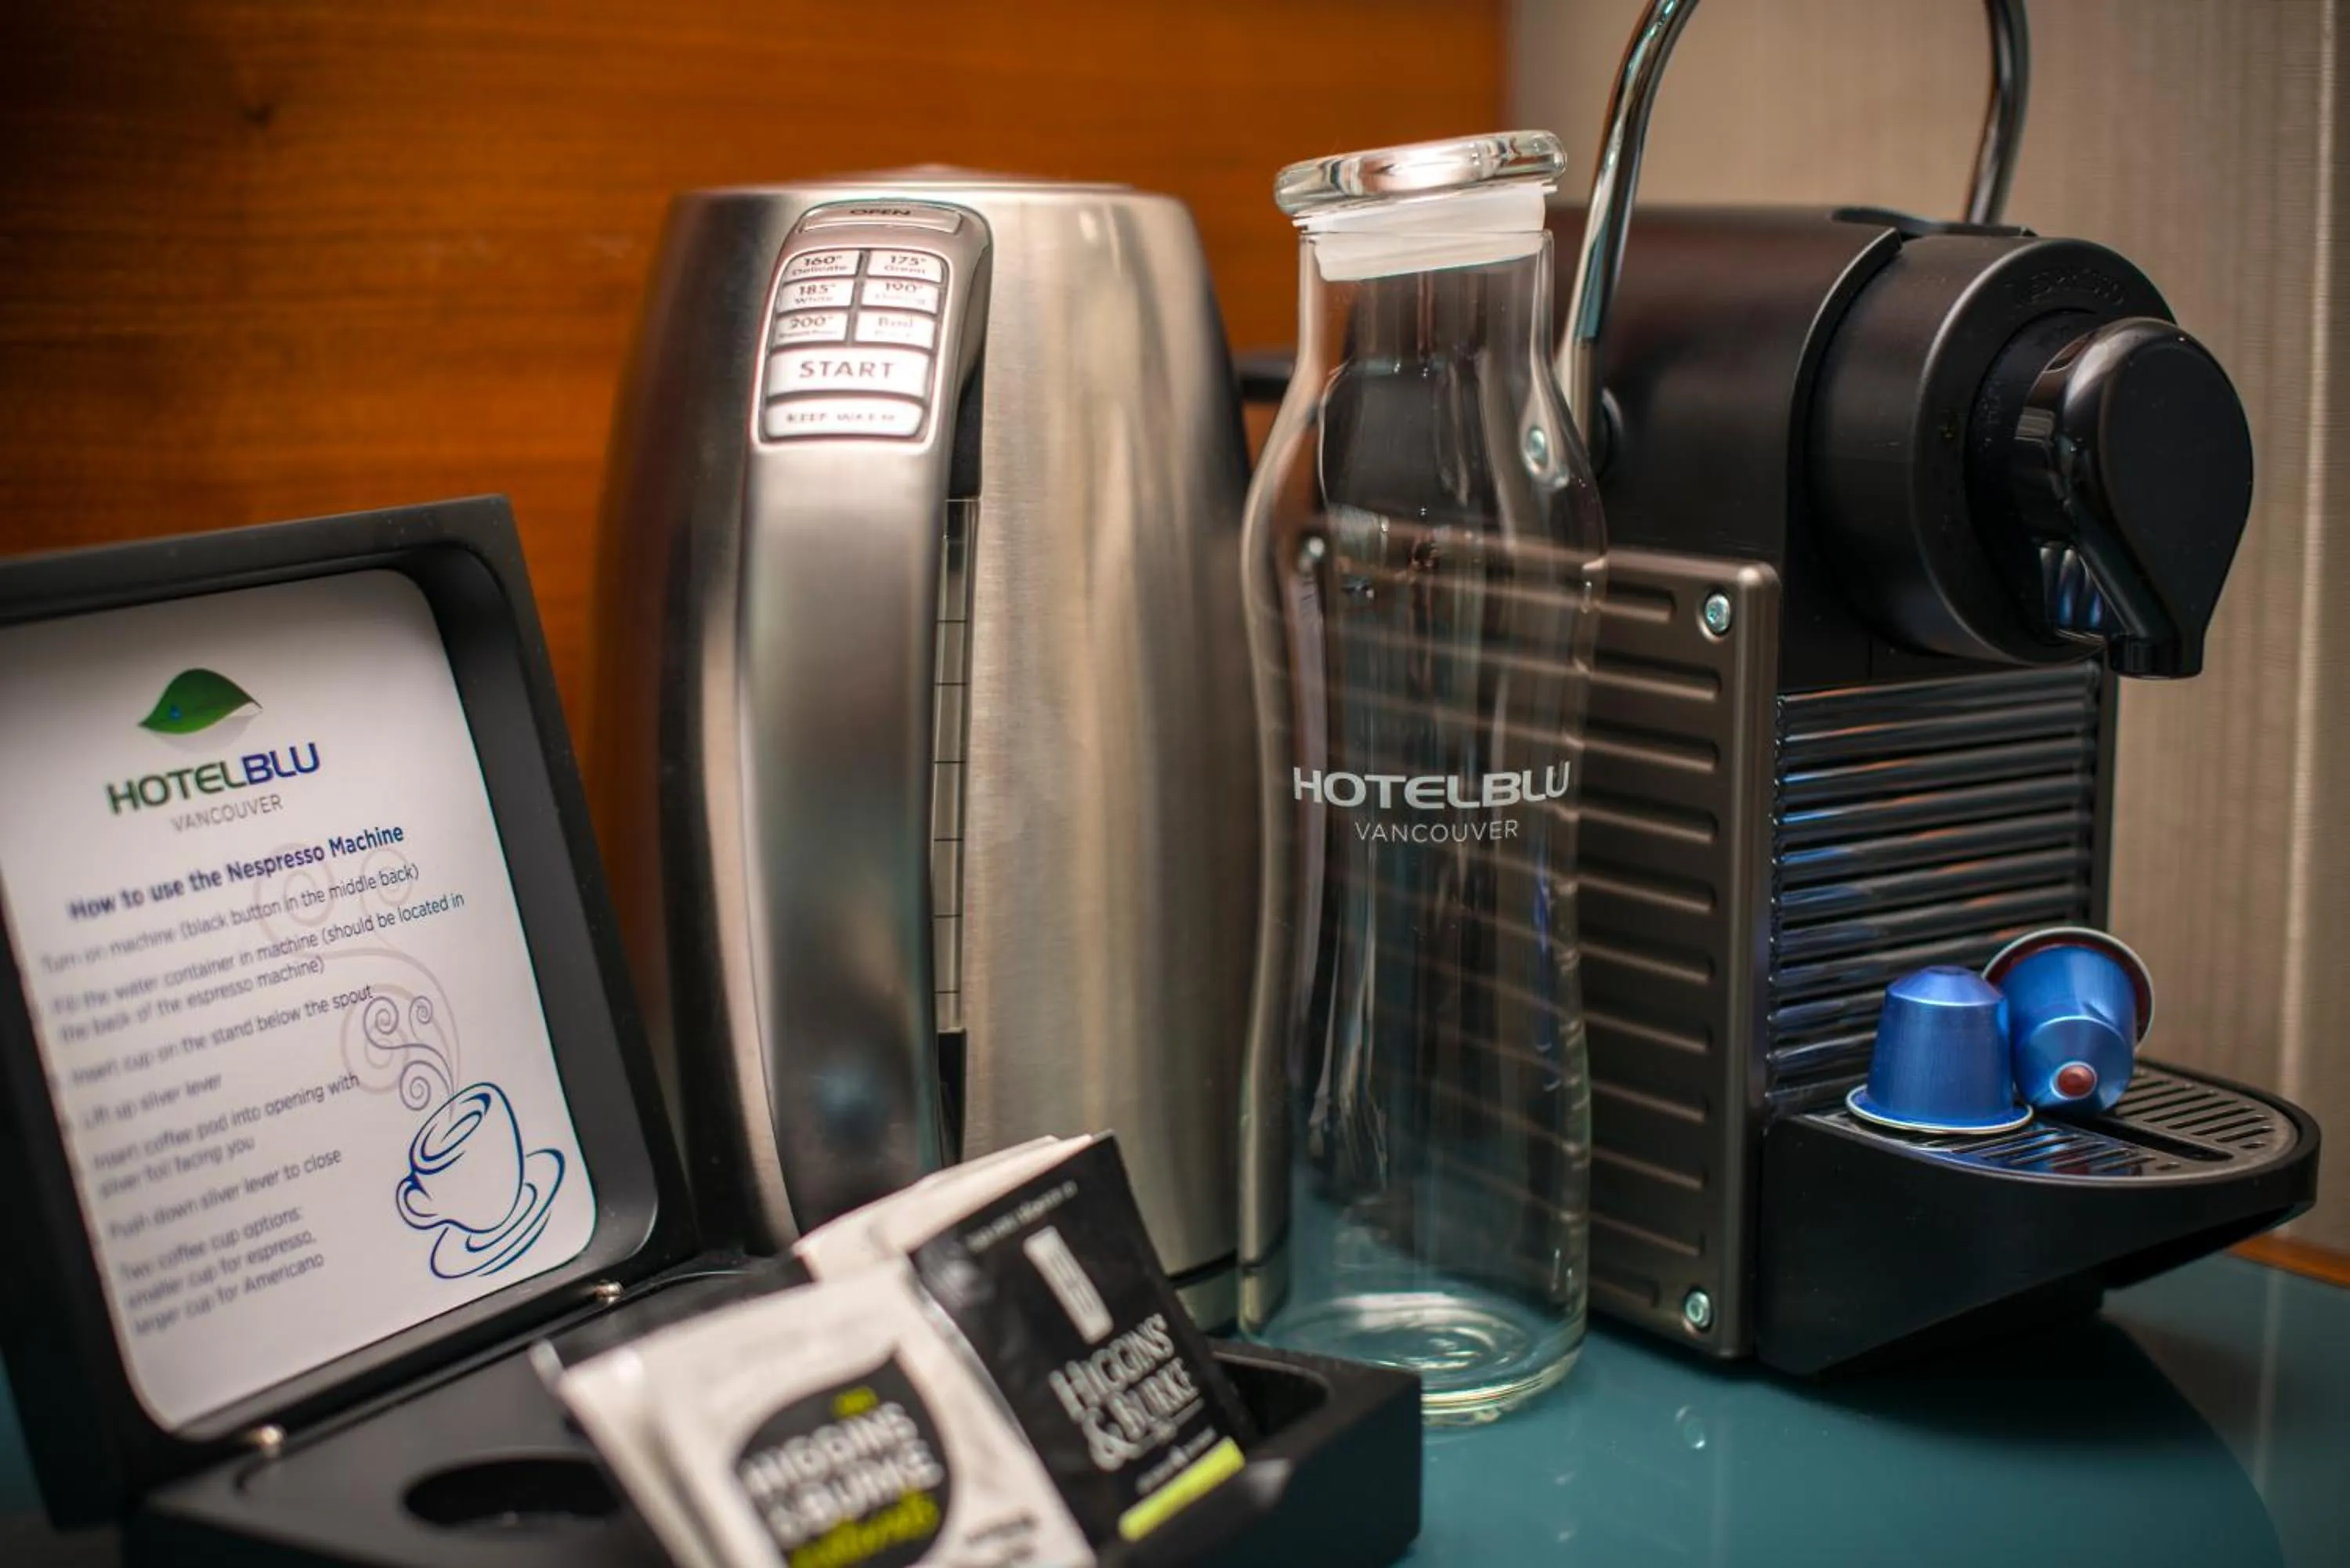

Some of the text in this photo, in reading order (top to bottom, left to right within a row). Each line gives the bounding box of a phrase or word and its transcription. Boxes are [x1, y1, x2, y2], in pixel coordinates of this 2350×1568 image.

[850, 208, 911, 216] OPEN
[799, 361, 895, 378] START
[171, 794, 284, 833] VANCOUVER
[1354, 819, 1519, 844] VANCOUVER
[69, 826, 404, 921] How to use the Nespresso Machine
[230, 901, 282, 927] button
[285, 895, 299, 912] in
[301, 889, 325, 908] the
[329, 875, 377, 901] middle
[379, 863, 419, 887] back)
[164, 956, 235, 986] container
[240, 951, 254, 966] in
[258, 933, 319, 962] machine
[322, 915, 374, 945] (should
[378, 911, 396, 929] be
[398, 895, 449, 923] located
[450, 892, 465, 908] in
[187, 978, 255, 1010] espresso
[257, 955, 325, 988] machine)
[212, 1017, 255, 1045] stand
[257, 1006, 301, 1032] below
[304, 999, 330, 1017] the
[333, 985, 373, 1009] spout
[197, 1115, 229, 1140] pod
[232, 1104, 261, 1127] into
[265, 1085, 325, 1116] opening
[328, 1071, 360, 1096] with
[226, 1136, 255, 1158] you
[244, 1170, 279, 1195] lever
[284, 1162, 301, 1181] to
[304, 1148, 342, 1175] close
[244, 1253, 325, 1295] Americano
